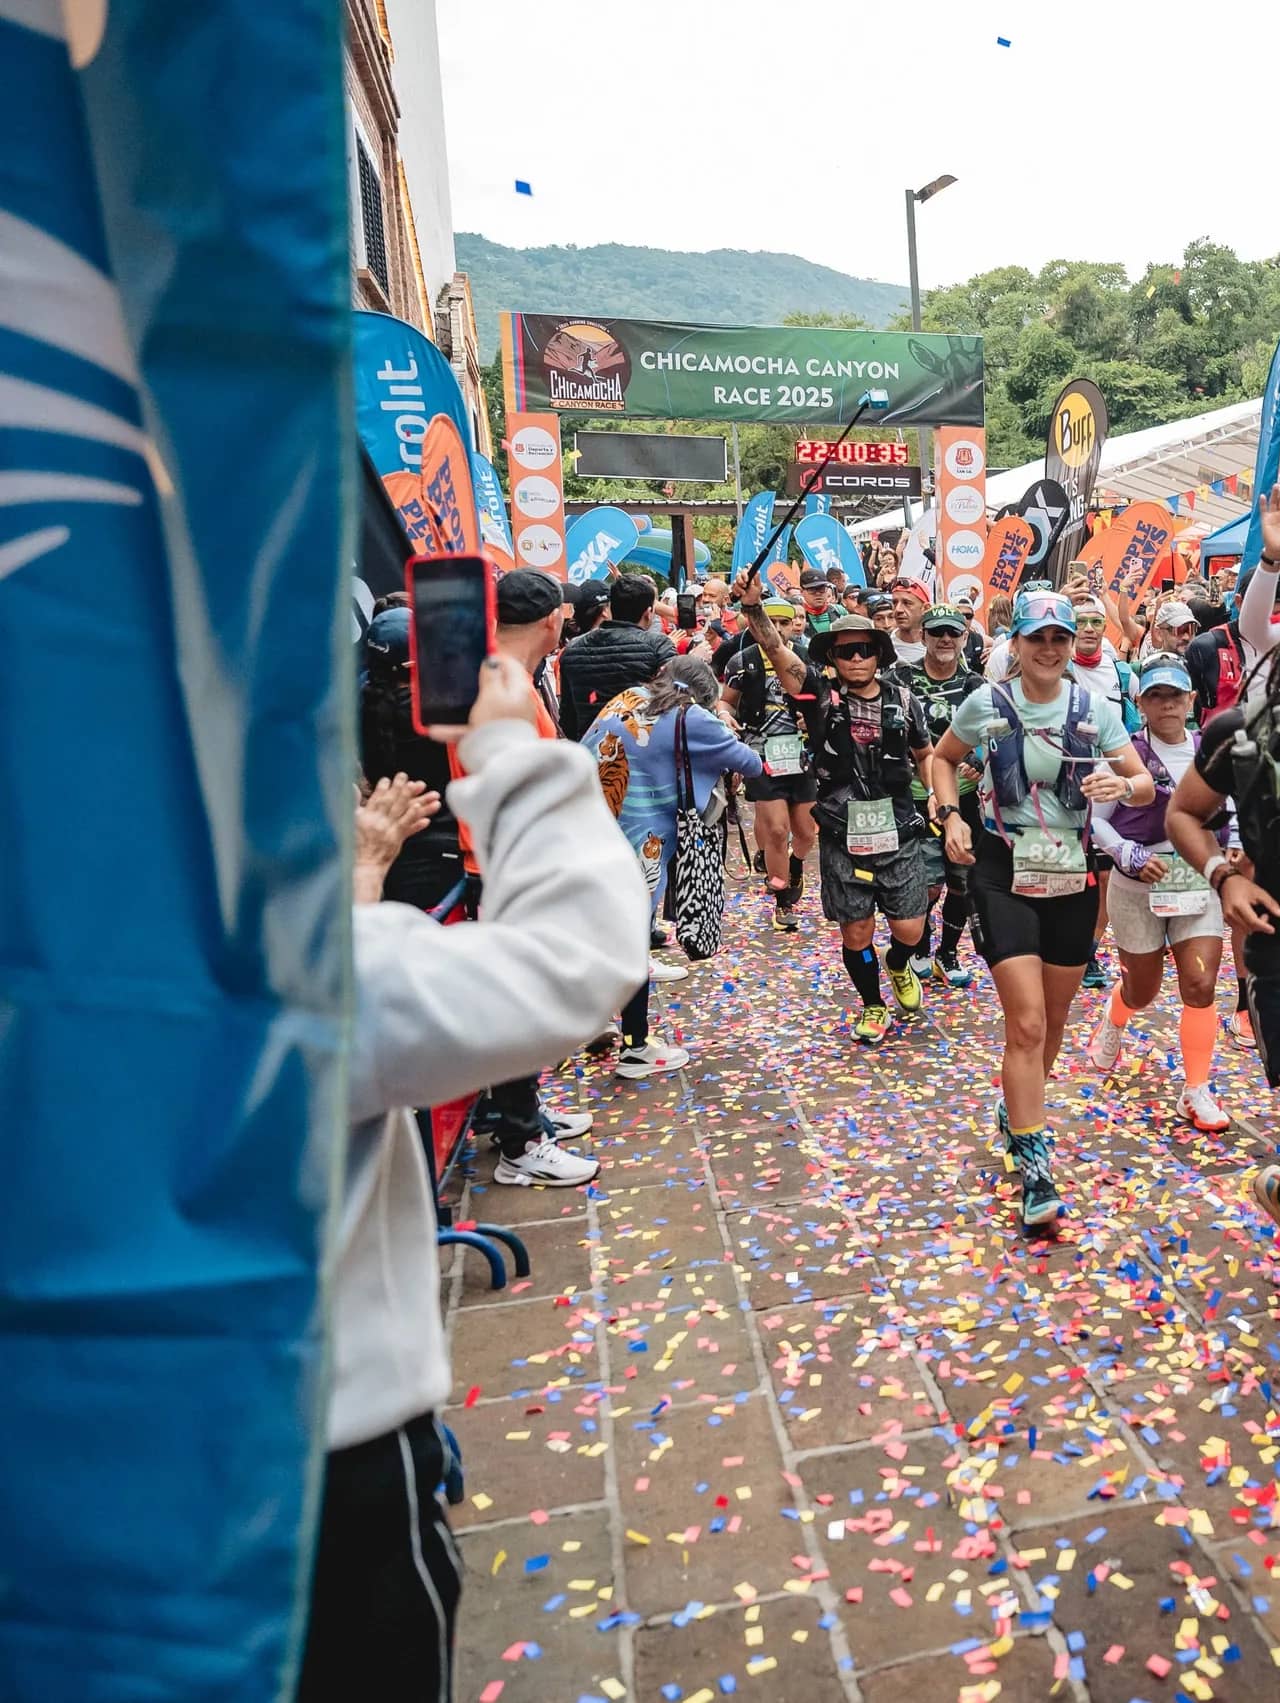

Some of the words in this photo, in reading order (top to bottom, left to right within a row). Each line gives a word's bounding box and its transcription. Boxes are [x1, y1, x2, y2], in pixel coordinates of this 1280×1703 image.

[639, 351, 800, 376] CHICAMOCHA
[805, 358, 899, 380] CANYON
[550, 370, 623, 401] CHICAMOCHA
[558, 401, 594, 409] CANYON
[594, 401, 618, 410] RACE
[713, 386, 771, 406] RACE
[776, 386, 834, 408] 2025
[376, 357, 428, 472] rolit
[825, 476, 911, 488] COROS
[567, 531, 623, 587] OKA
[951, 545, 980, 554] HOKA
[989, 529, 1018, 588] PEOPLE
[932, 607, 955, 617] VOLT
[772, 743, 797, 756] 865
[855, 811, 887, 828] 895
[1029, 843, 1073, 866] 822
